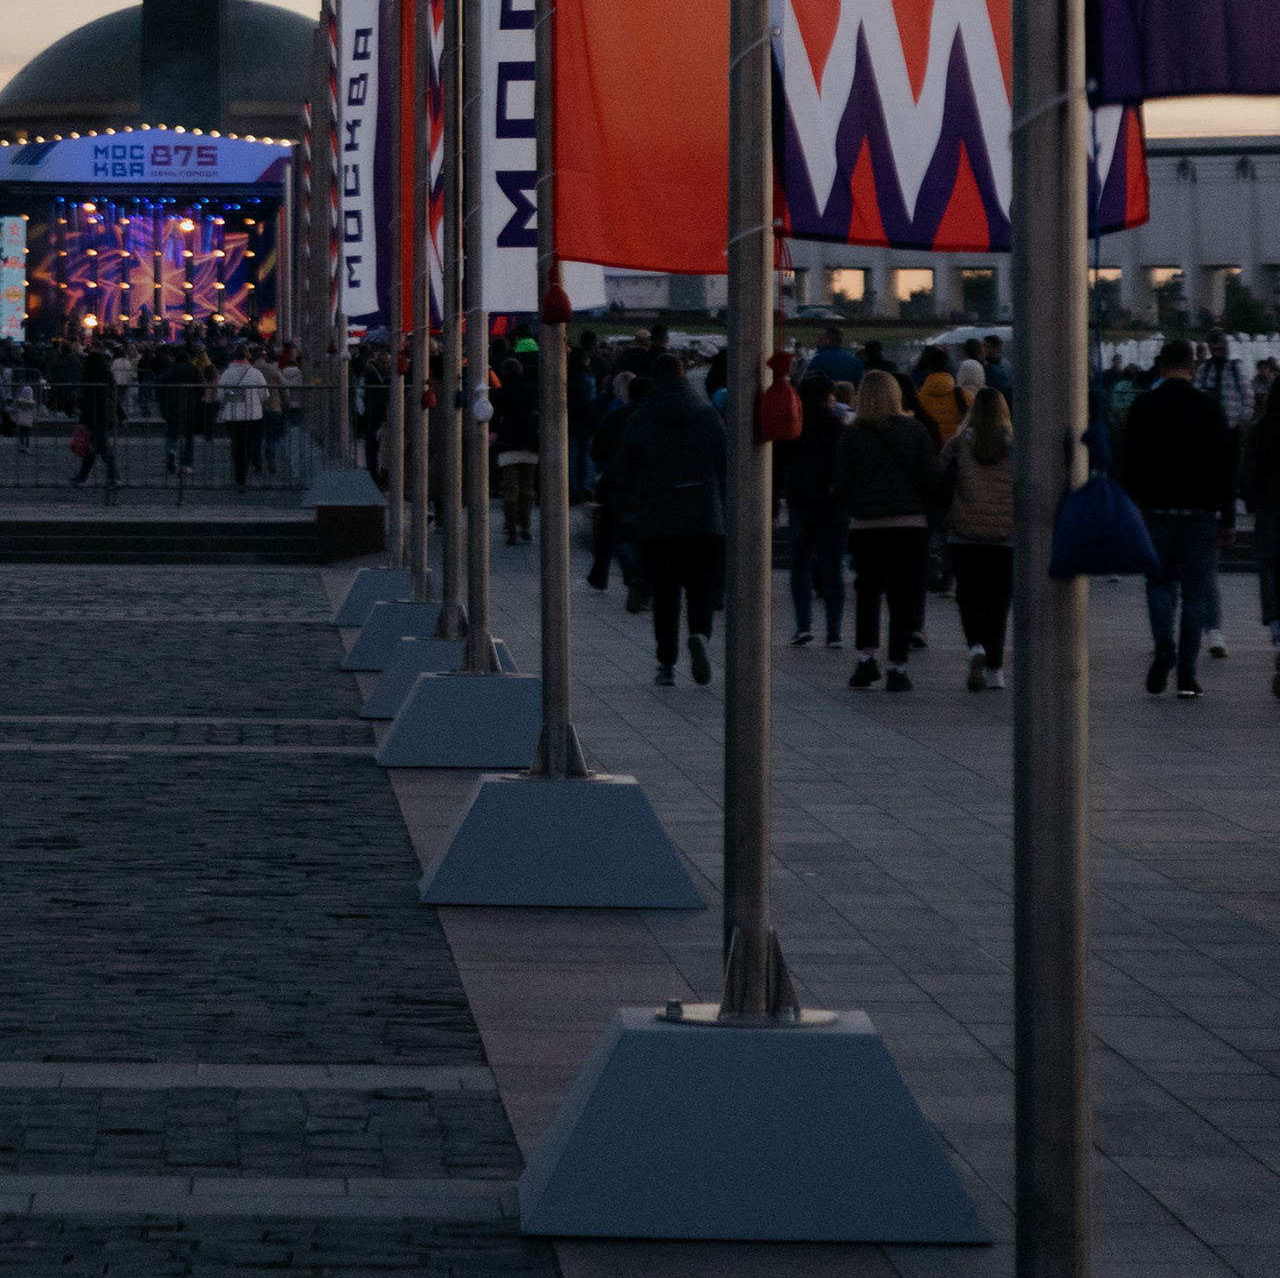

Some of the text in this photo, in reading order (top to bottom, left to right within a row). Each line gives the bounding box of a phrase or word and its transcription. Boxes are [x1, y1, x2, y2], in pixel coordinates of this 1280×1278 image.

[93, 144, 145, 160] МОС
[150, 145, 219, 167] 875
[344, 27, 373, 289] МОСКВА
[93, 162, 145, 177] КВА
